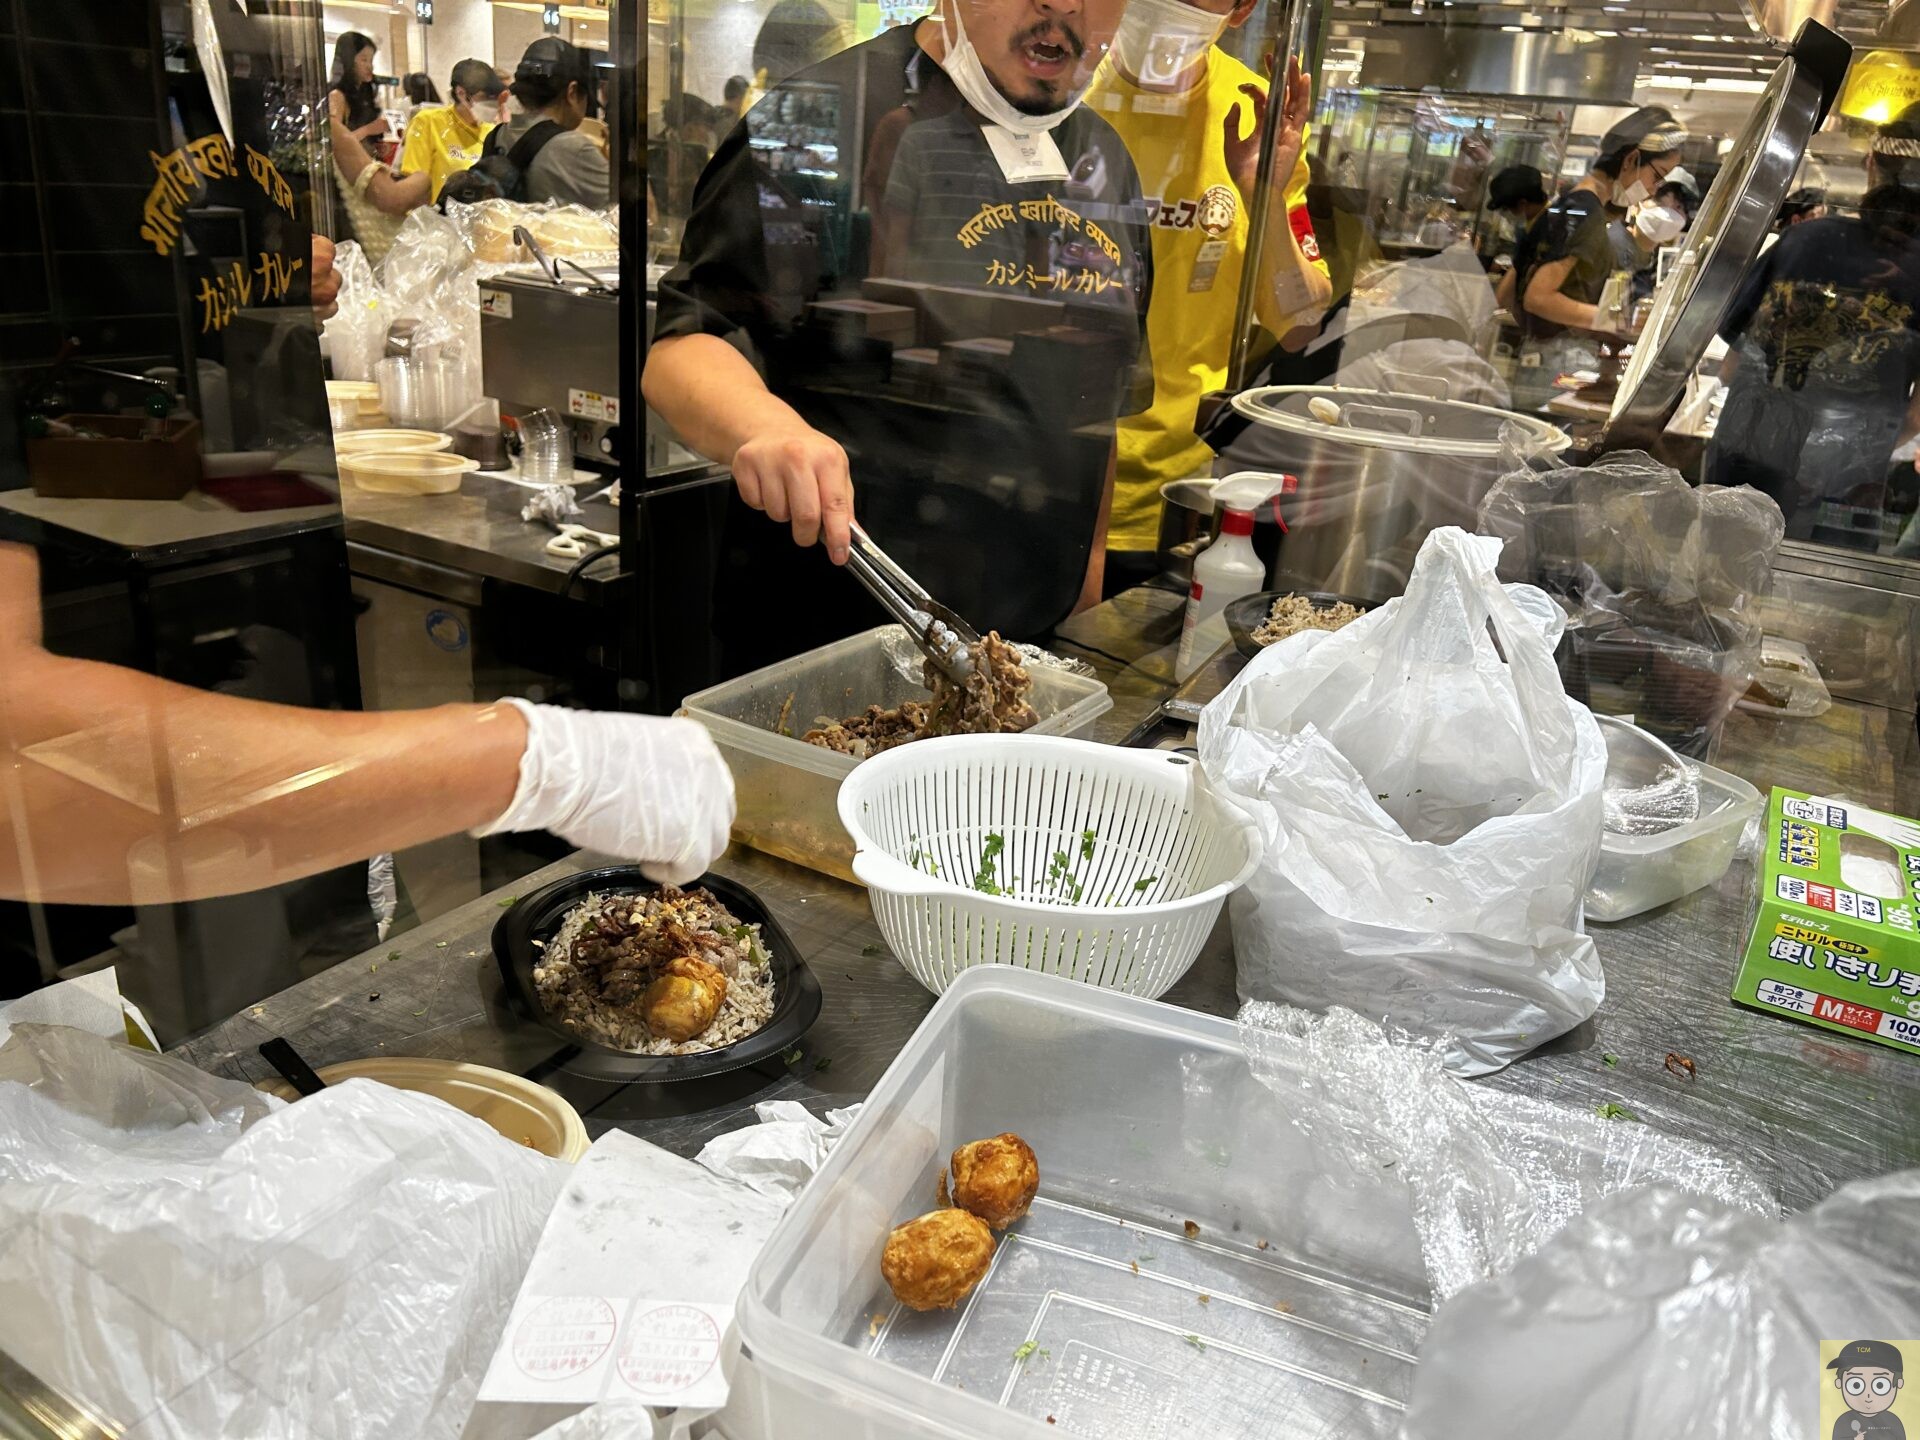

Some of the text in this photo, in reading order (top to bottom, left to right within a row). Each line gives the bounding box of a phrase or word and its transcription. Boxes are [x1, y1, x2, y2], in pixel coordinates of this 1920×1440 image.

[1782, 926, 1830, 945] ニトリル
[1774, 984, 1805, 999] 粉つき
[1767, 994, 1804, 1011] ホワイト
[1820, 1000, 1844, 1020] M
[1846, 1006, 1873, 1019] サイズ
